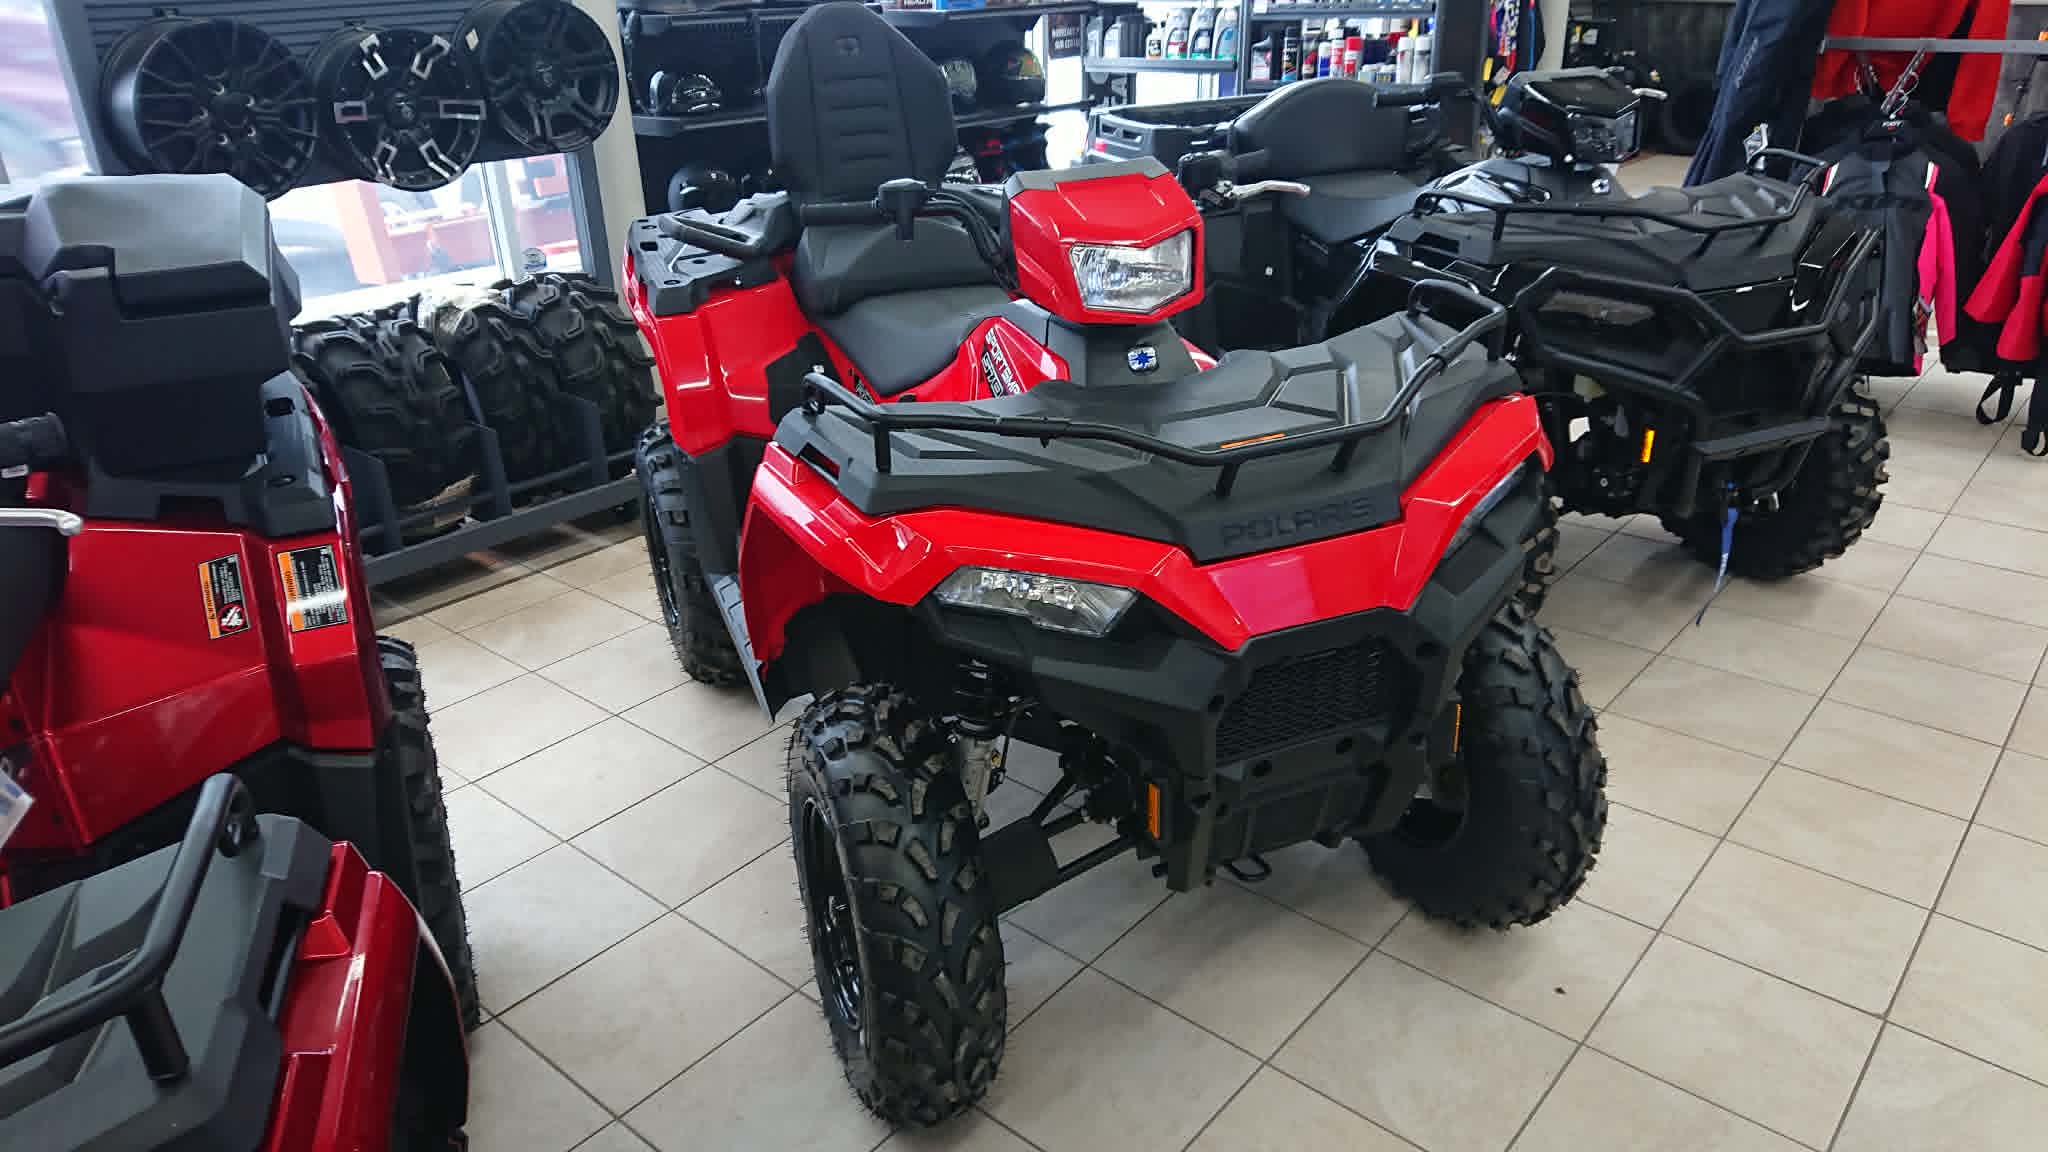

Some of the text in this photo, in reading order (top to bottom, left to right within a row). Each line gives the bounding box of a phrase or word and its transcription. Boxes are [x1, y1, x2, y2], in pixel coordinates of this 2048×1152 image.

[981, 352, 1004, 398] 570
[985, 328, 1020, 394] SPORTSMA
[1221, 498, 1374, 546] POLARIS
